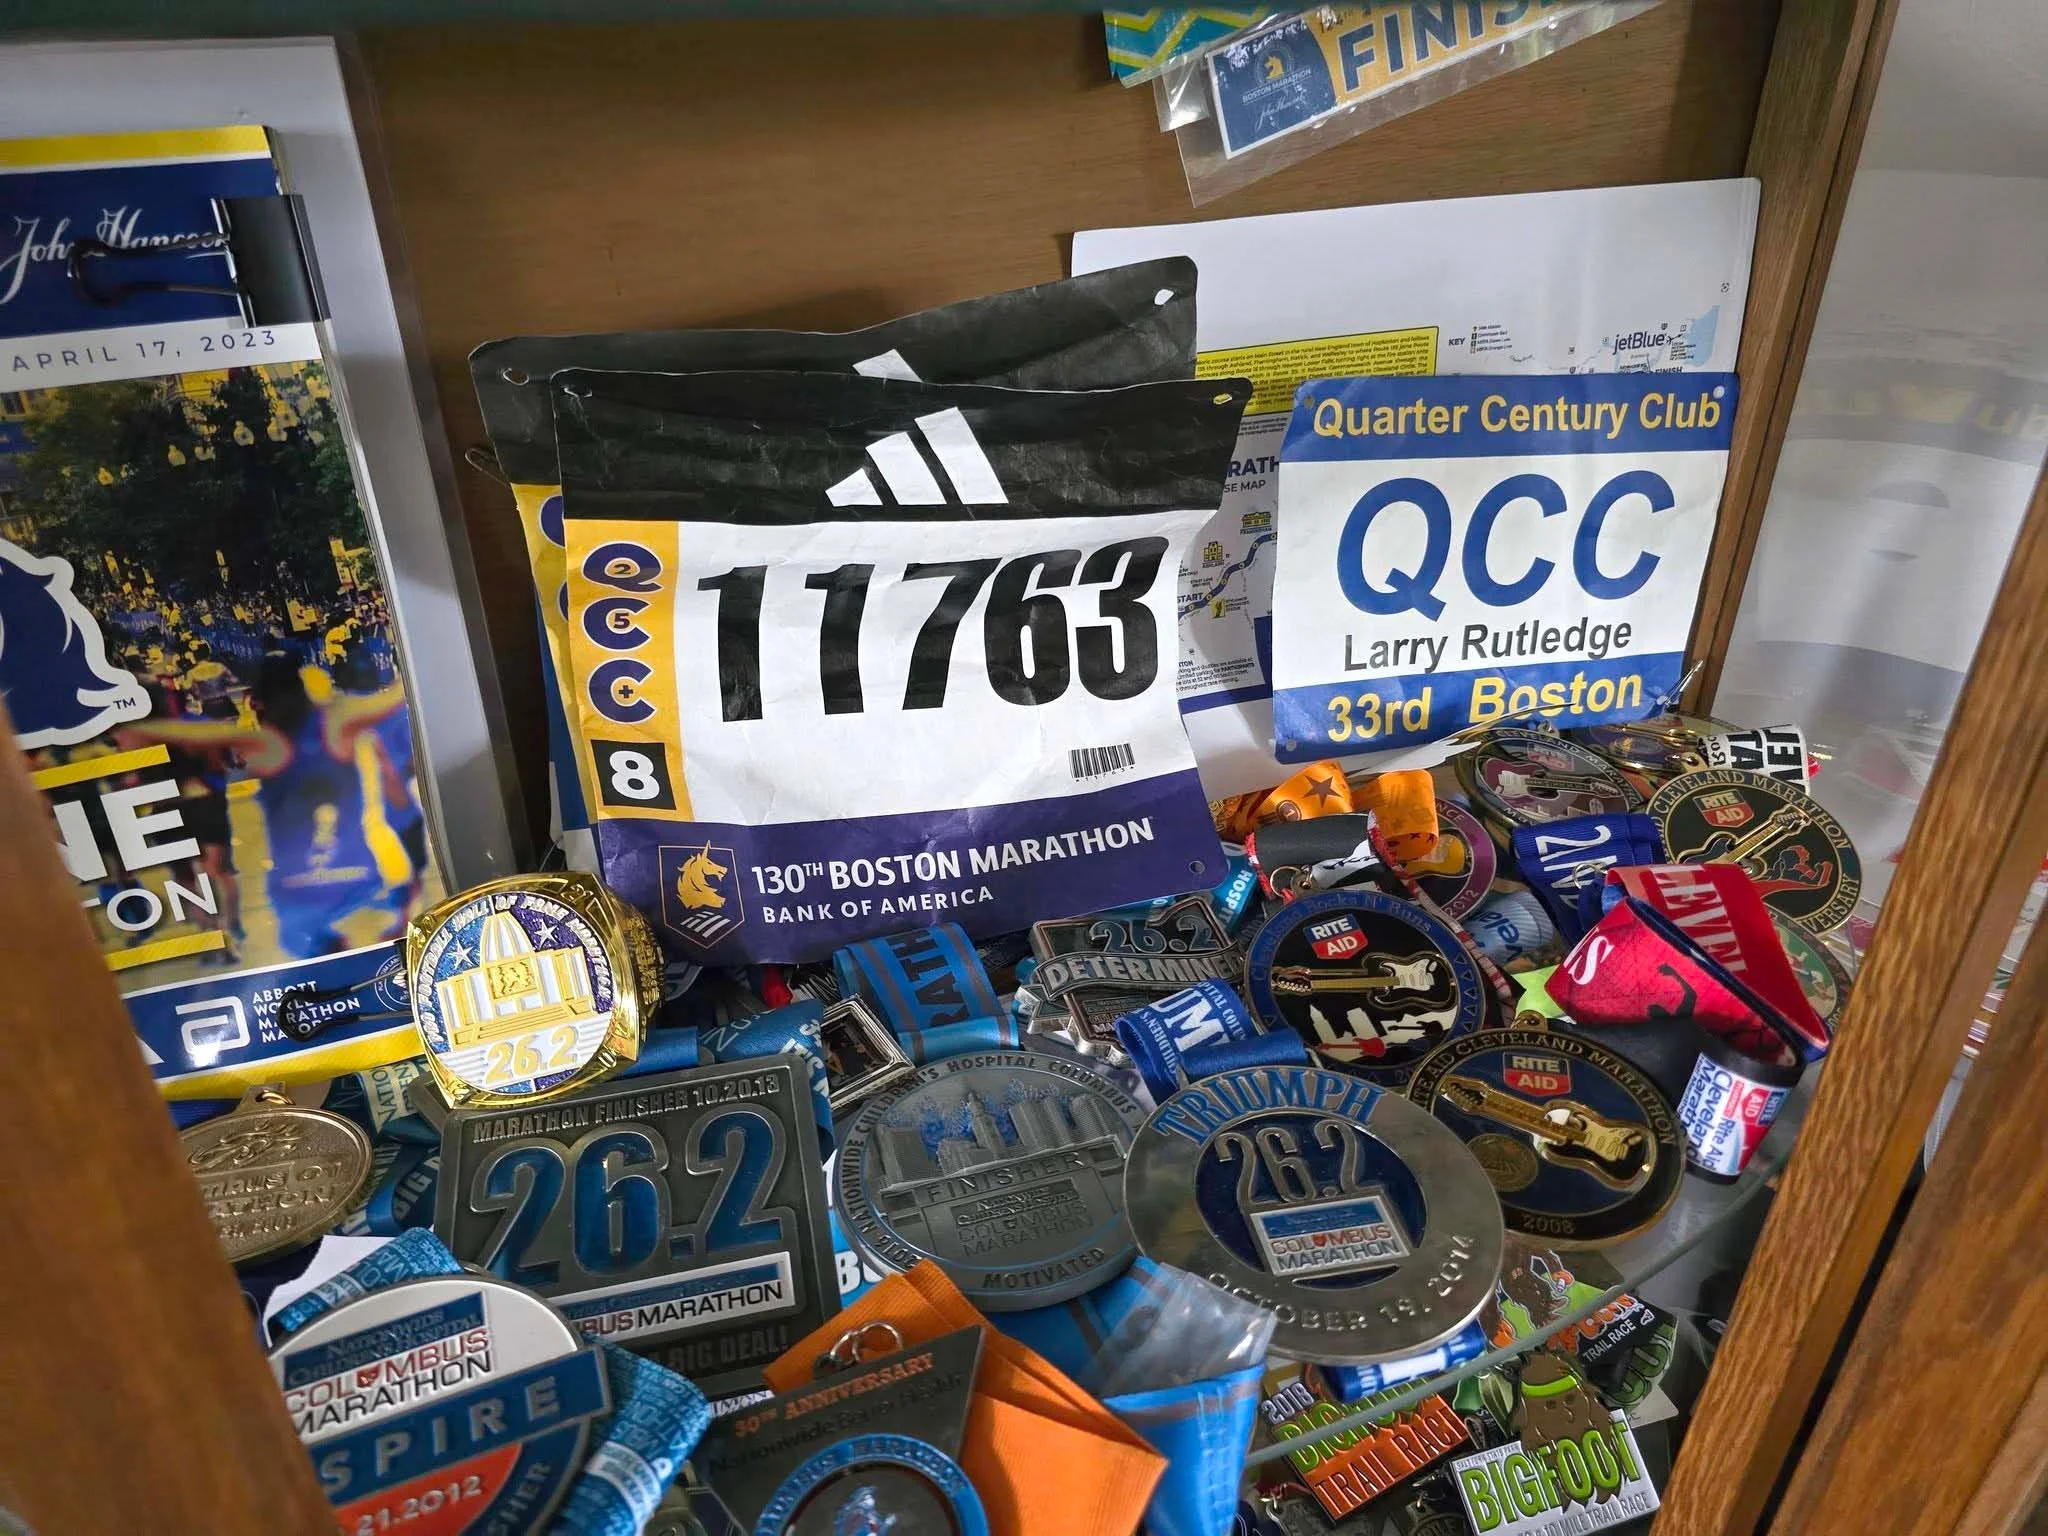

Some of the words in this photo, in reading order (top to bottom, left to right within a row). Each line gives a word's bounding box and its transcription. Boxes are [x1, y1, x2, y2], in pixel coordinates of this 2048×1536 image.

[12, 343, 118, 373] APRIL
[136, 340, 182, 358] 17,
[199, 329, 277, 353] 2023
[1448, 337, 1466, 346] KEY
[1612, 331, 1666, 355] jetBlue
[1313, 398, 1469, 439] Quarter
[1481, 394, 1628, 440] Century
[1639, 392, 1721, 430] Club
[1241, 479, 1266, 491] MAP
[1337, 470, 1676, 622] QCC
[698, 537, 1170, 722] 11763
[1344, 631, 1449, 673] Larry
[1461, 616, 1632, 661] Rutledge
[113, 696, 136, 710] TM
[1327, 687, 1432, 743] 33rd
[1469, 670, 1643, 724] Boston
[609, 750, 660, 800] 8
[1654, 771, 1745, 813] CLEVELAND
[1751, 773, 1851, 850] MARATHON
[1716, 807, 1746, 825] AID
[752, 860, 824, 895] 130TH
[831, 849, 961, 891] BOSTON
[968, 816, 1154, 875] MARATHON
[763, 902, 835, 925] BANK
[841, 898, 873, 919] OF
[881, 886, 994, 916] AMERICA
[1311, 917, 1354, 939] RITE
[1091, 914, 1218, 955] 26.2
[1326, 936, 1358, 957] AID
[483, 1024, 579, 1086] 26.2
[1511, 1056, 1561, 1073] RITE
[947, 1054, 1038, 1071] HOSPITAL
[1048, 1059, 1137, 1116] COLUMBUS
[1149, 1066, 1385, 1146] TRIUMPH
[1455, 1031, 1584, 1056] CLEVELAND
[1588, 1049, 1676, 1146] MARATHON
[1517, 1074, 1558, 1091] AID
[472, 1108, 589, 1143] MARATHON
[595, 1088, 689, 1125] FINISHER
[693, 1073, 781, 1108] 10.20.13
[1686, 1069, 1734, 1162] Cleveland
[1712, 1118, 1736, 1145] Rite
[926, 1152, 1084, 1200] FINISHER
[1214, 1119, 1384, 1209] 26.2
[470, 1103, 797, 1287] 26.2
[1522, 1213, 1577, 1235] 2008
[981, 1247, 1107, 1291] MOTIVATED
[1276, 1239, 1400, 1272] MARATHON
[637, 1281, 783, 1329] MARATHON
[1582, 1337, 1613, 1363] TRAIL
[1607, 1318, 1637, 1342] RACE
[783, 1351, 935, 1420] ANNIVERSARY
[1261, 1382, 1315, 1425] 2018
[1315, 1449, 1401, 1515] TRAIL
[1389, 1407, 1469, 1471] RACE
[1457, 1420, 1641, 1534] BIGFOOT
[1559, 1513, 1586, 1534] MILE
[1585, 1502, 1621, 1527] TRAIL
[1621, 1491, 1652, 1516] RACE
